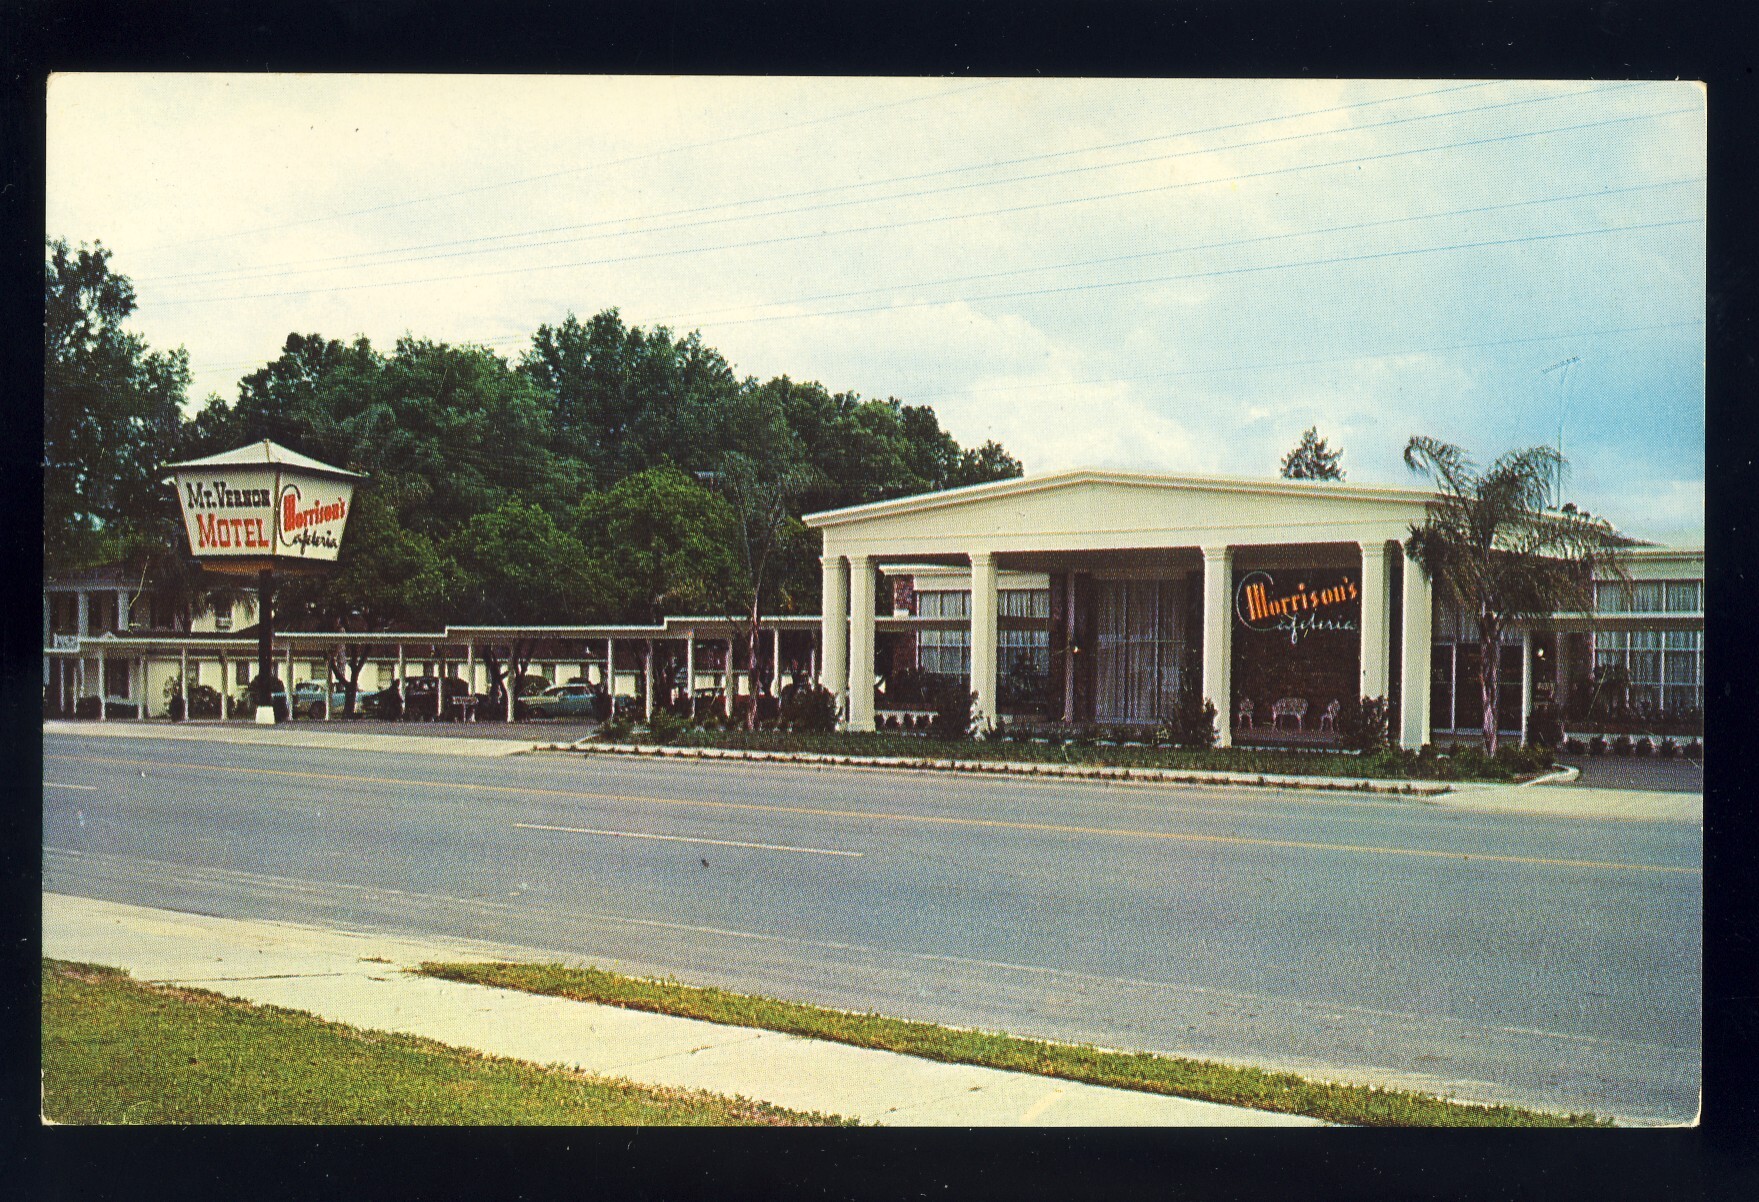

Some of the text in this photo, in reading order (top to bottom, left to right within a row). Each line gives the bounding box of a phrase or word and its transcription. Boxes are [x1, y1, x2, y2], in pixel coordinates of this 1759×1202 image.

[196, 513, 270, 548] MOTEL
[279, 484, 338, 555] Cafeteria
[283, 496, 346, 533] Morrison's
[1246, 575, 1357, 621] Morrison's
